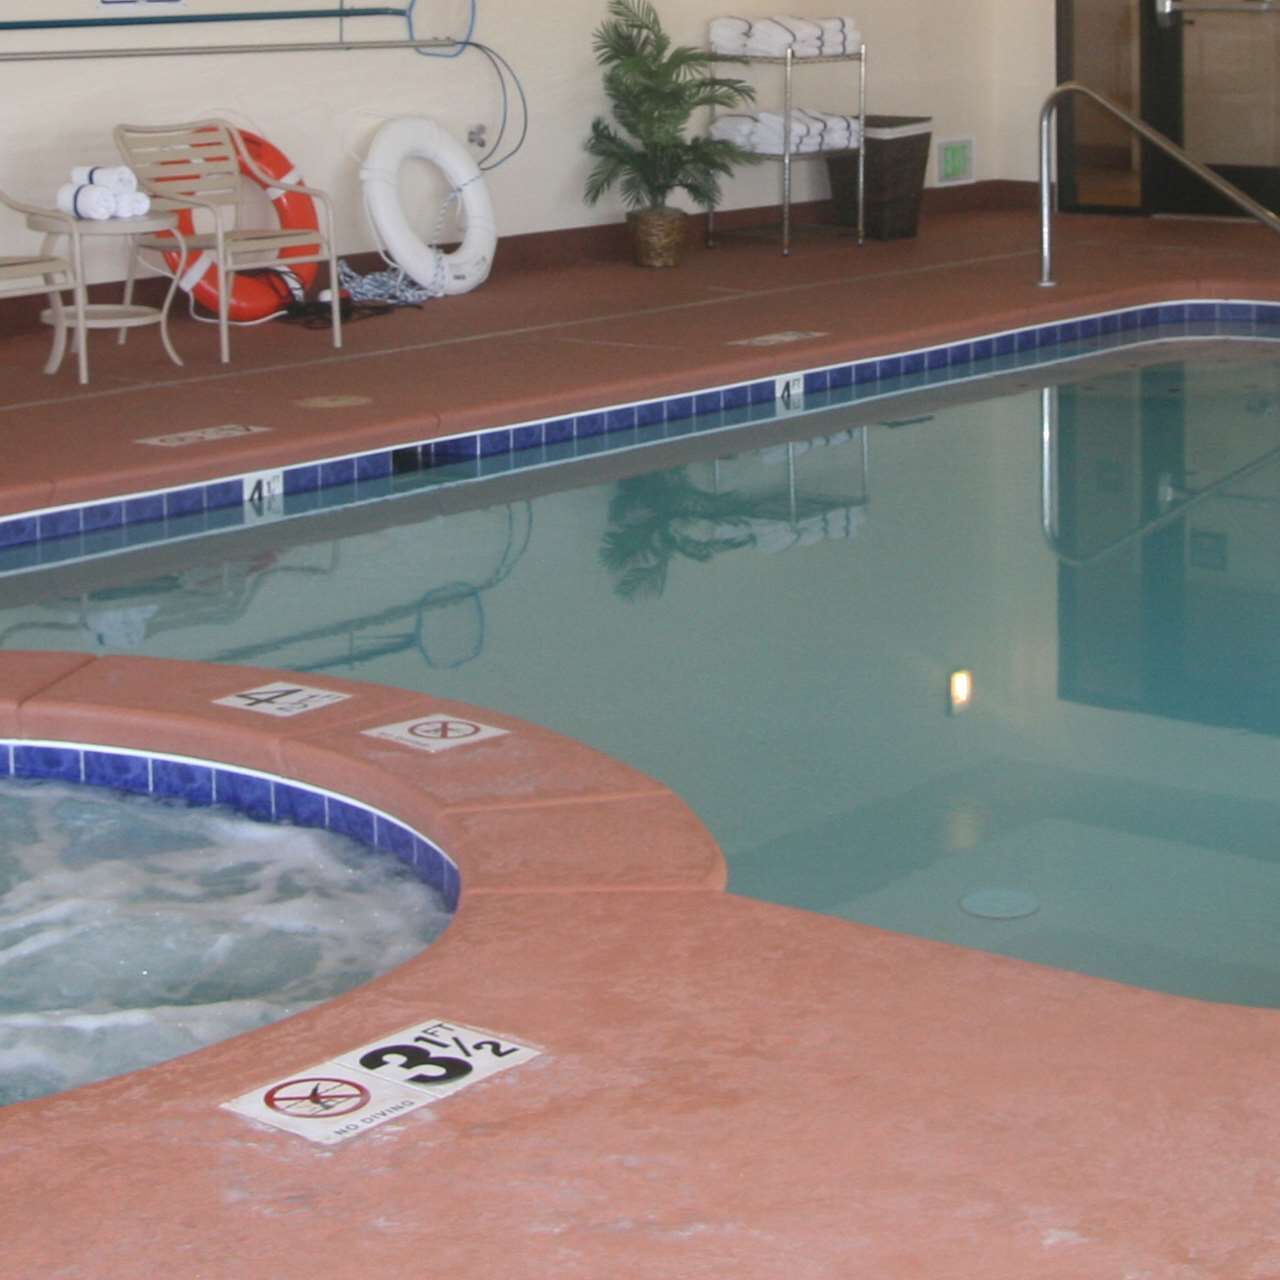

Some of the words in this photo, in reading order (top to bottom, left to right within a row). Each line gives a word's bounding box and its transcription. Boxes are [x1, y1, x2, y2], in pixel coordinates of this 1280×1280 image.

[422, 1022, 455, 1038] FT
[334, 1121, 360, 1136] NO
[360, 1099, 415, 1126] DIVING
